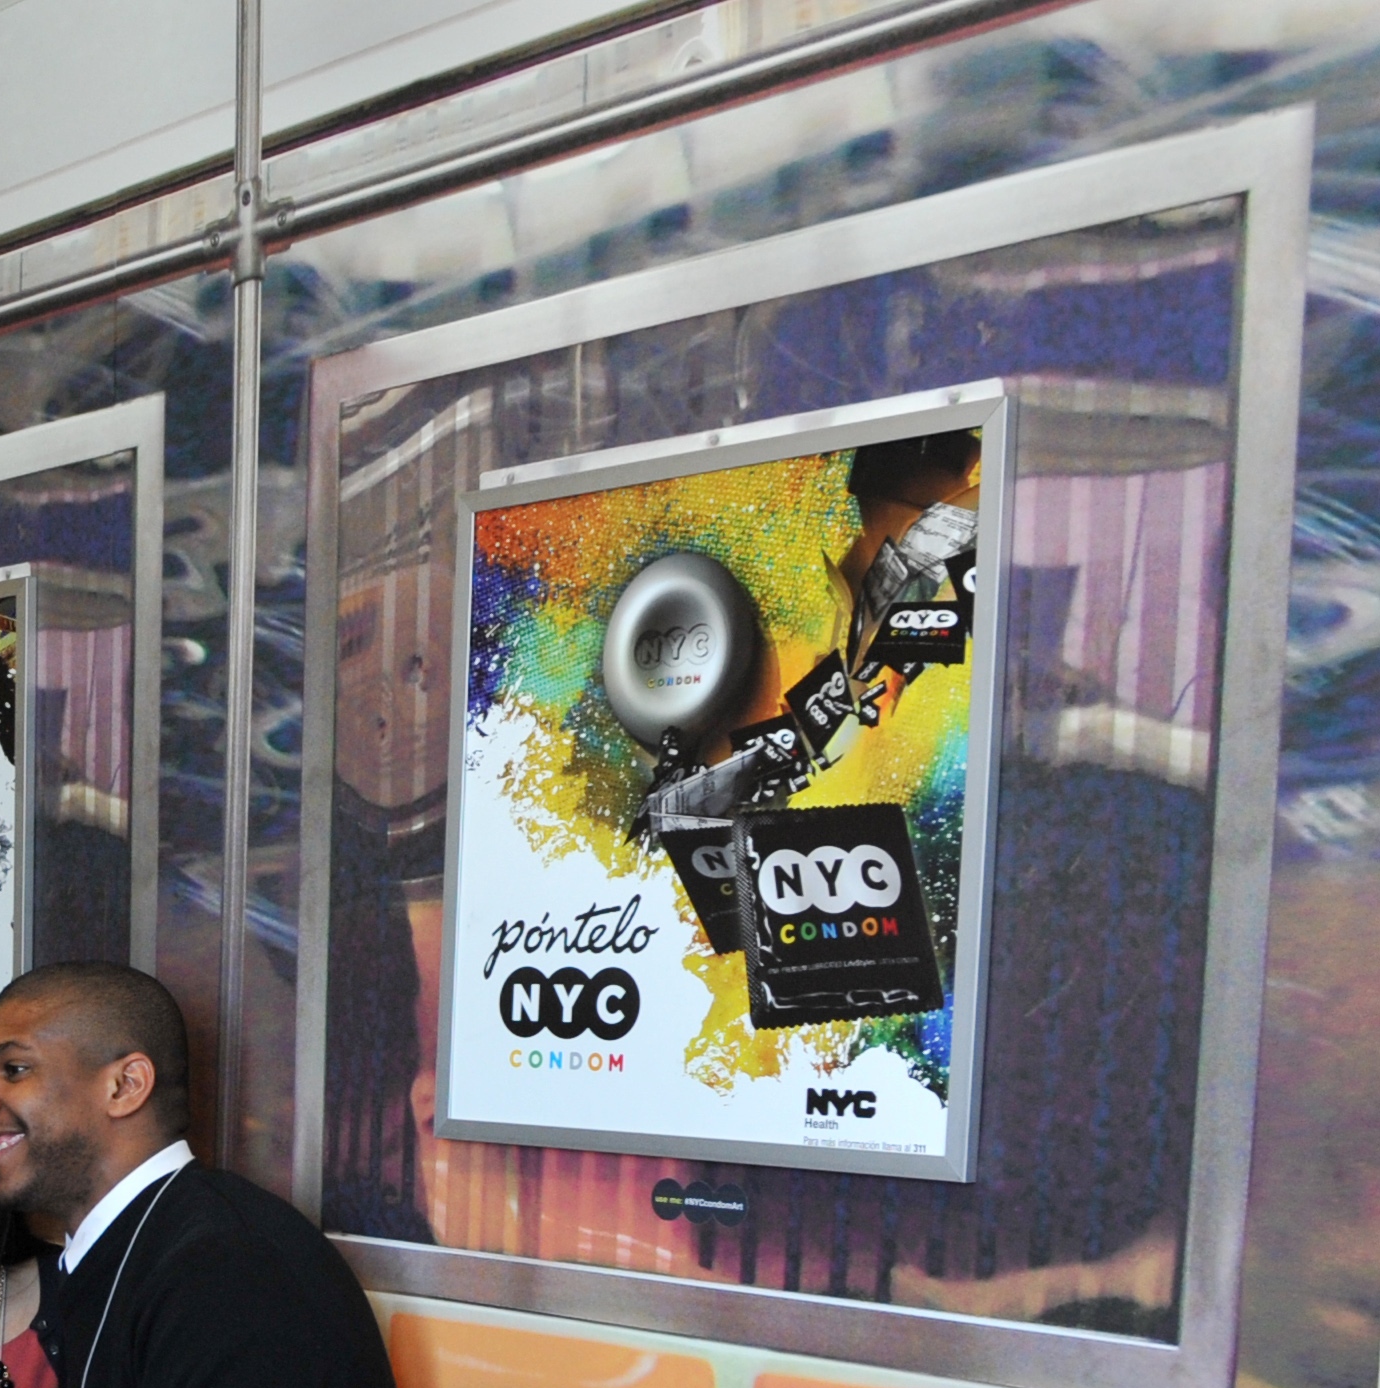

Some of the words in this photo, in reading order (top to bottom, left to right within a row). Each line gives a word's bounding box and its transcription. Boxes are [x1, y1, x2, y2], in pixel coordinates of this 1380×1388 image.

[894, 611, 952, 626] NYC
[636, 629, 712, 667] NYC
[647, 675, 702, 689] CONDOM
[770, 855, 891, 902] NYC
[483, 893, 660, 980] póntelo
[779, 916, 899, 945] CONDOM
[508, 980, 630, 1028] NYC
[509, 1049, 624, 1073] CONDOM
[806, 1087, 877, 1119] NYC
[804, 1117, 839, 1130] Health
[803, 1135, 819, 1147] Para
[913, 1143, 927, 1153] 311
